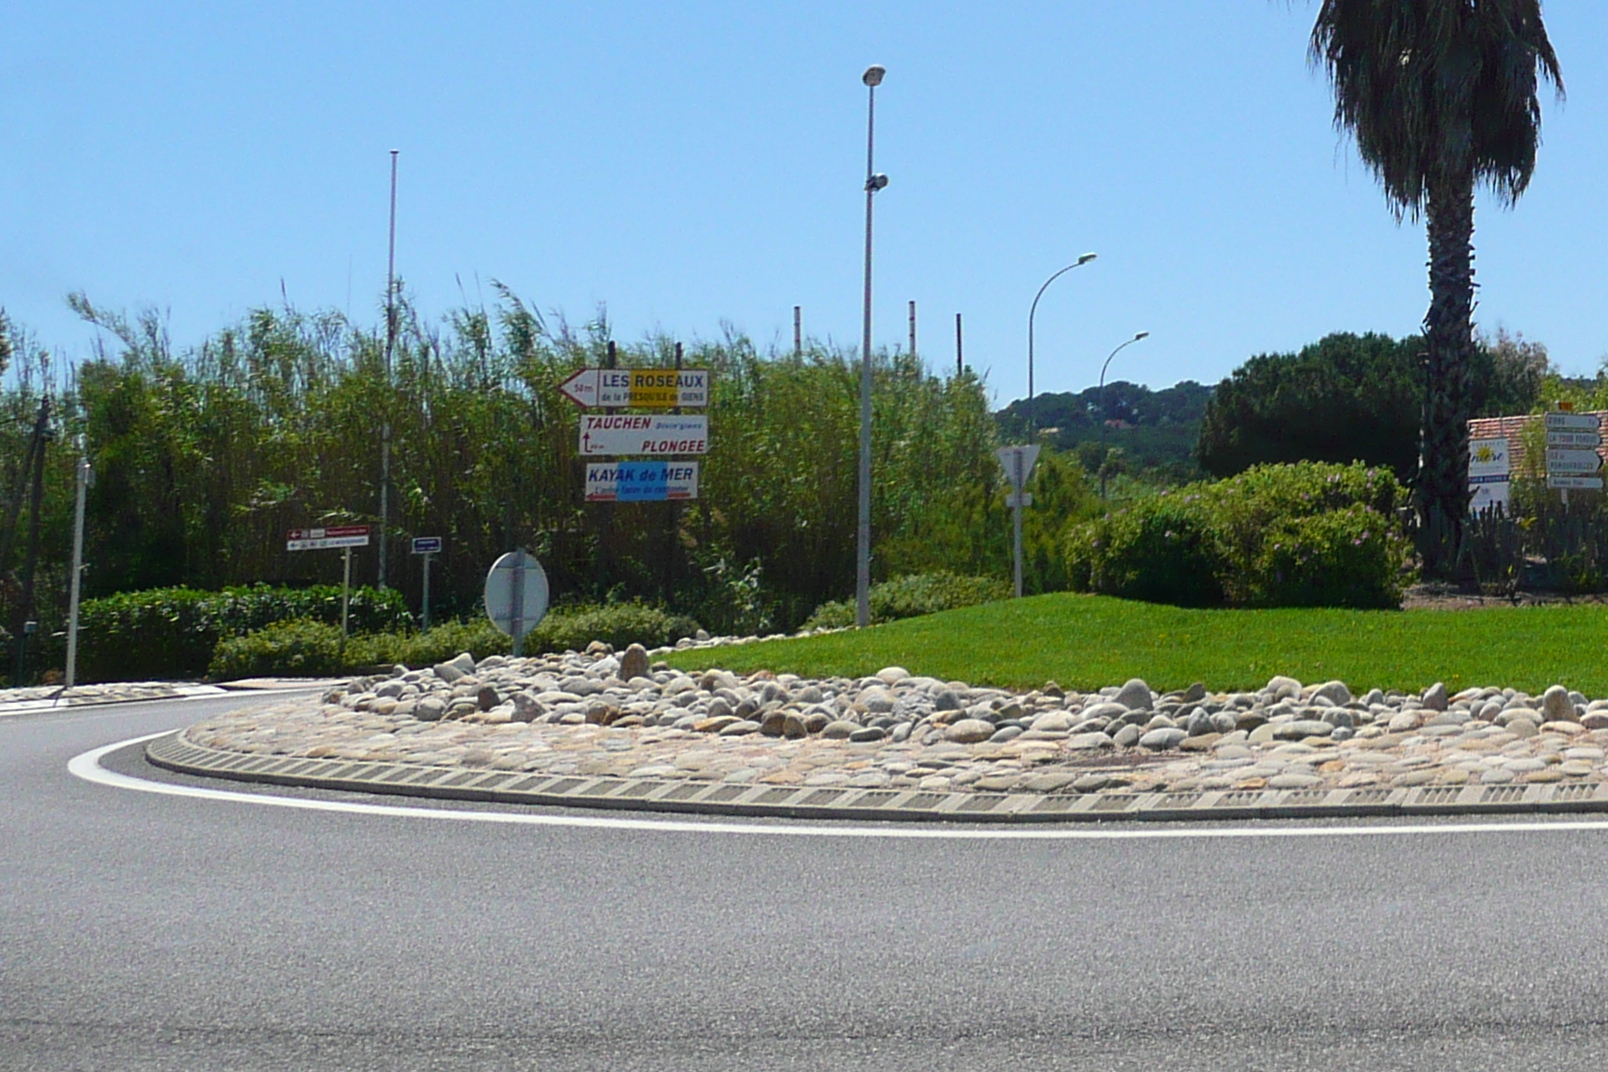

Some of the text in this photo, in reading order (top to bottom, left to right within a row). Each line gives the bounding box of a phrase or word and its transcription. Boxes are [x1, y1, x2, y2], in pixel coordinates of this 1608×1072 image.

[603, 375, 704, 388] LES ROSEAUX
[681, 392, 704, 402] GIENS
[587, 417, 652, 429] TAUCHEN
[641, 440, 705, 453] PLONGEE
[588, 468, 693, 482] KAYAK de MER
